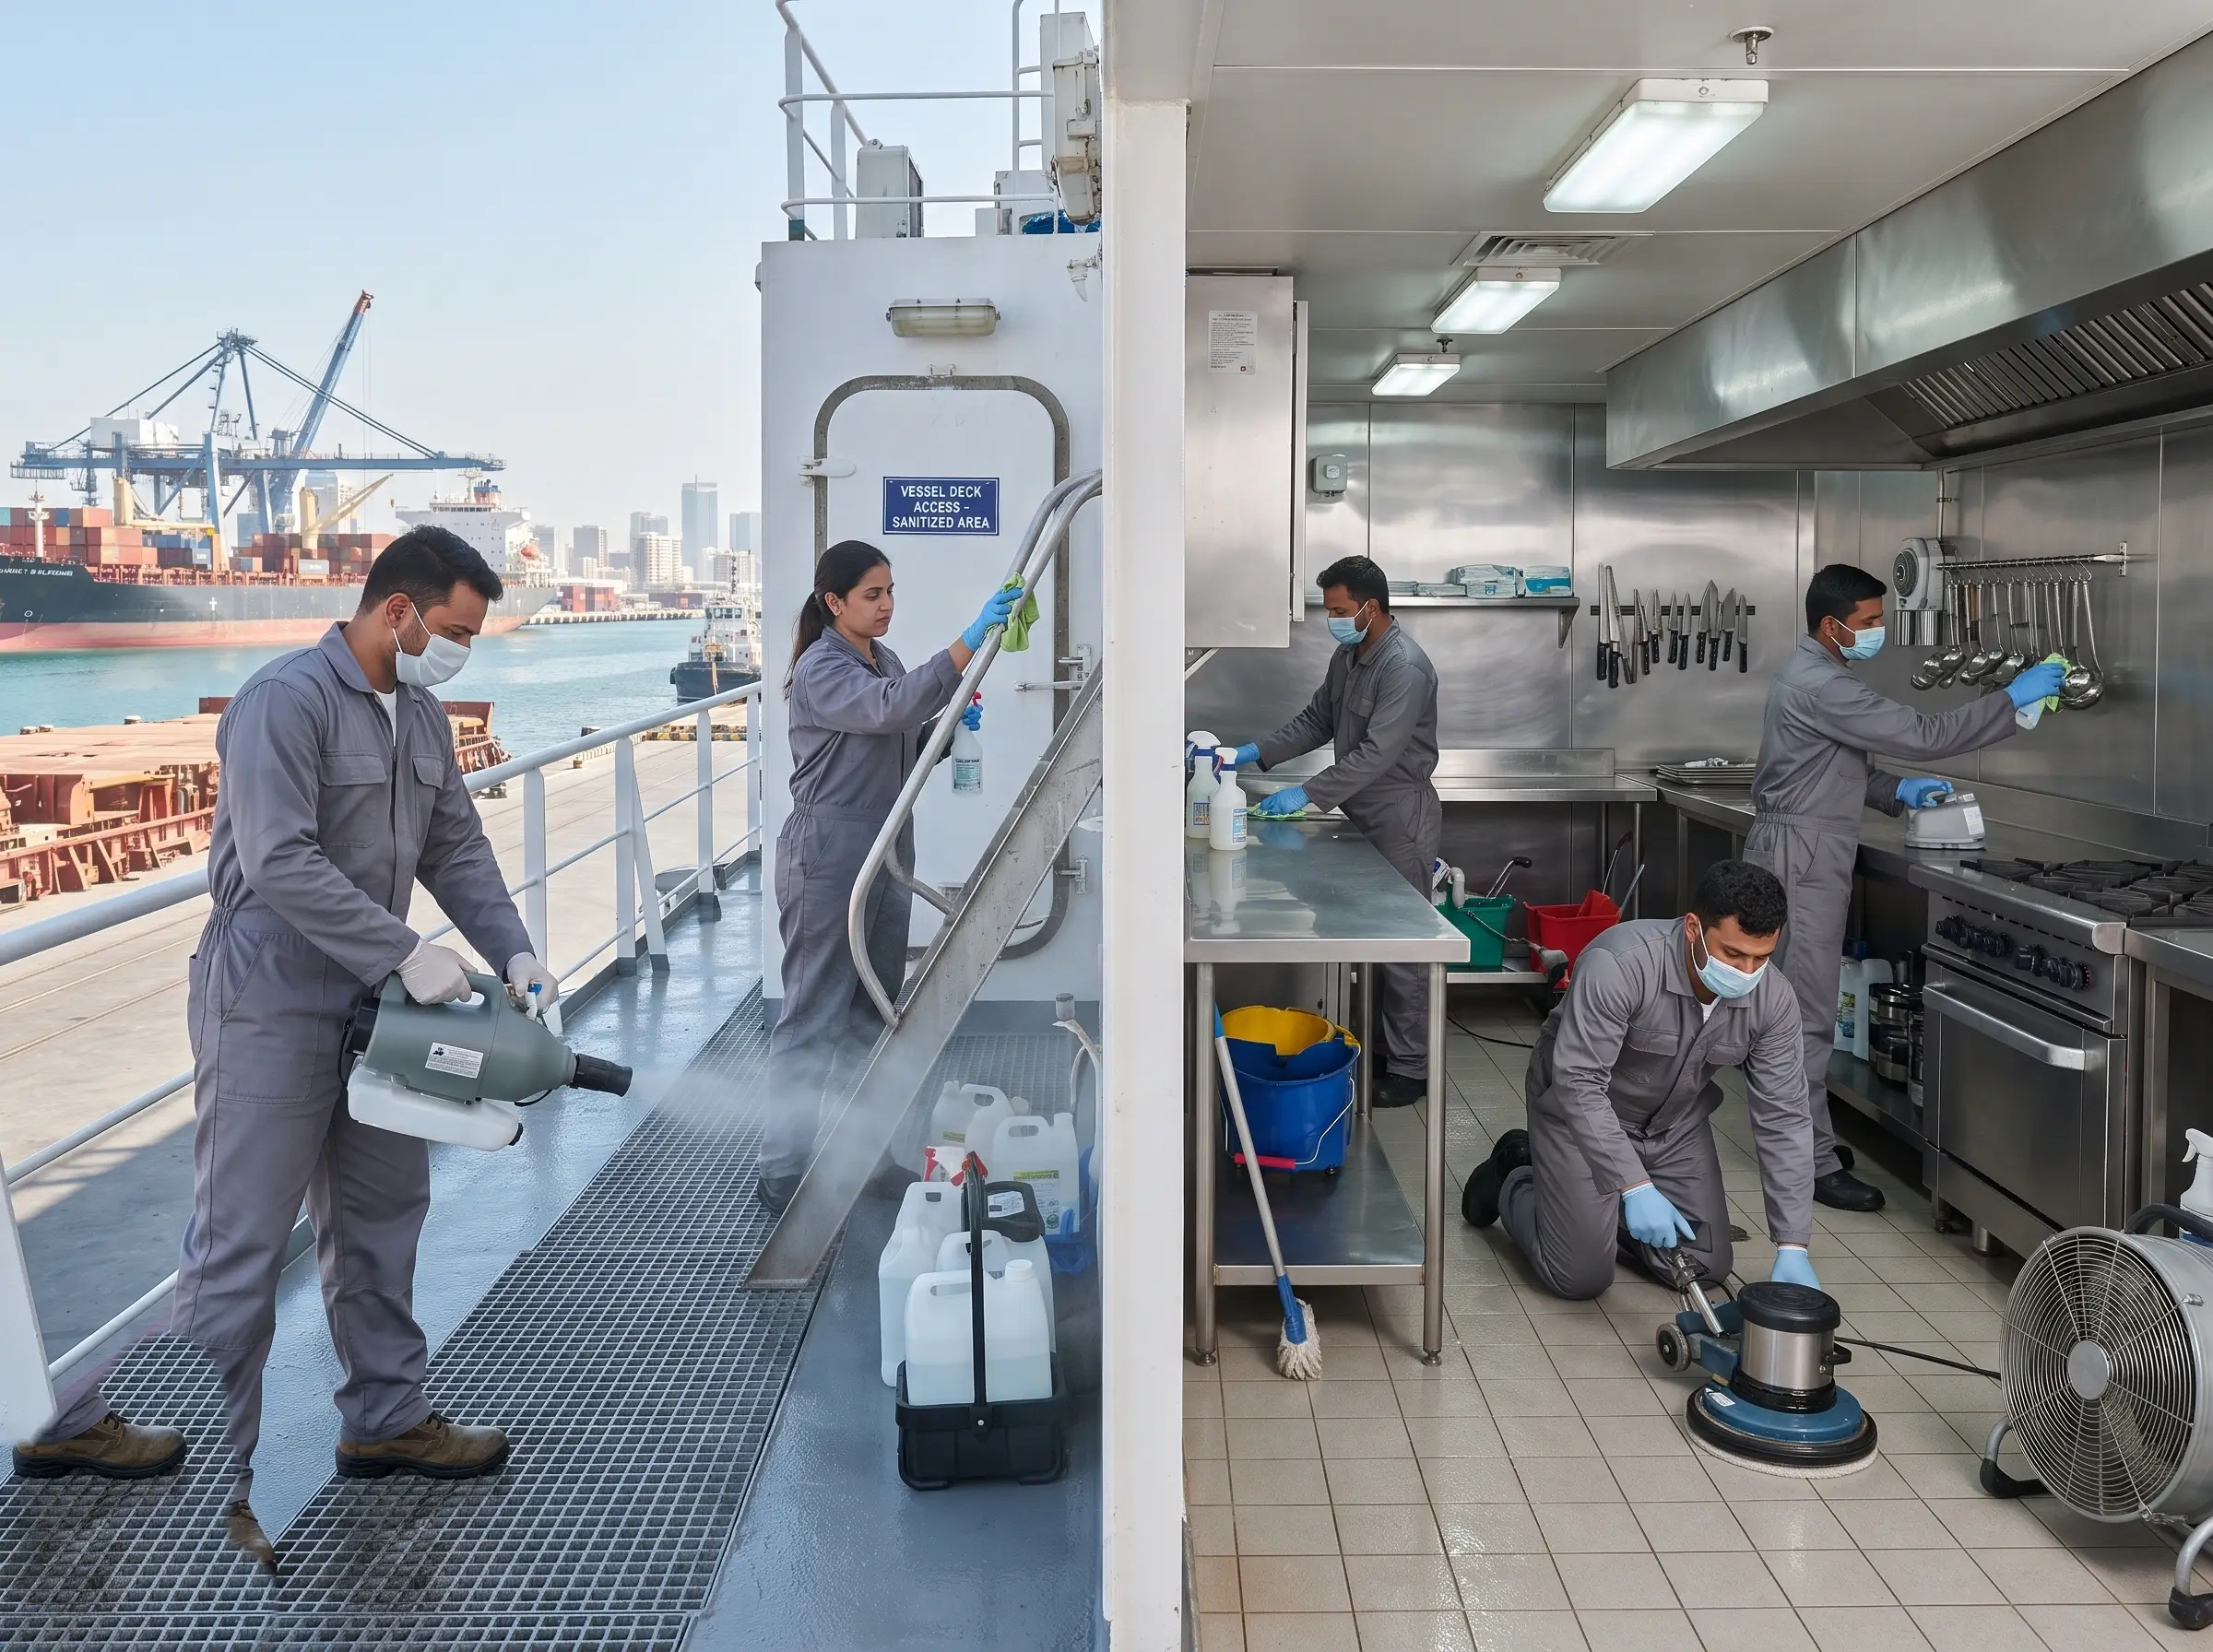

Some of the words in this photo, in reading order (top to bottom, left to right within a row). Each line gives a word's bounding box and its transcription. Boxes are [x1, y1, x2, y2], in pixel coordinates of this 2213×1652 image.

[901, 486, 945, 498] VESSEL
[950, 486, 982, 498] DECK
[914, 502, 960, 513] ACCESS
[893, 516, 953, 528] SANITIZED
[957, 516, 989, 528] AREA
